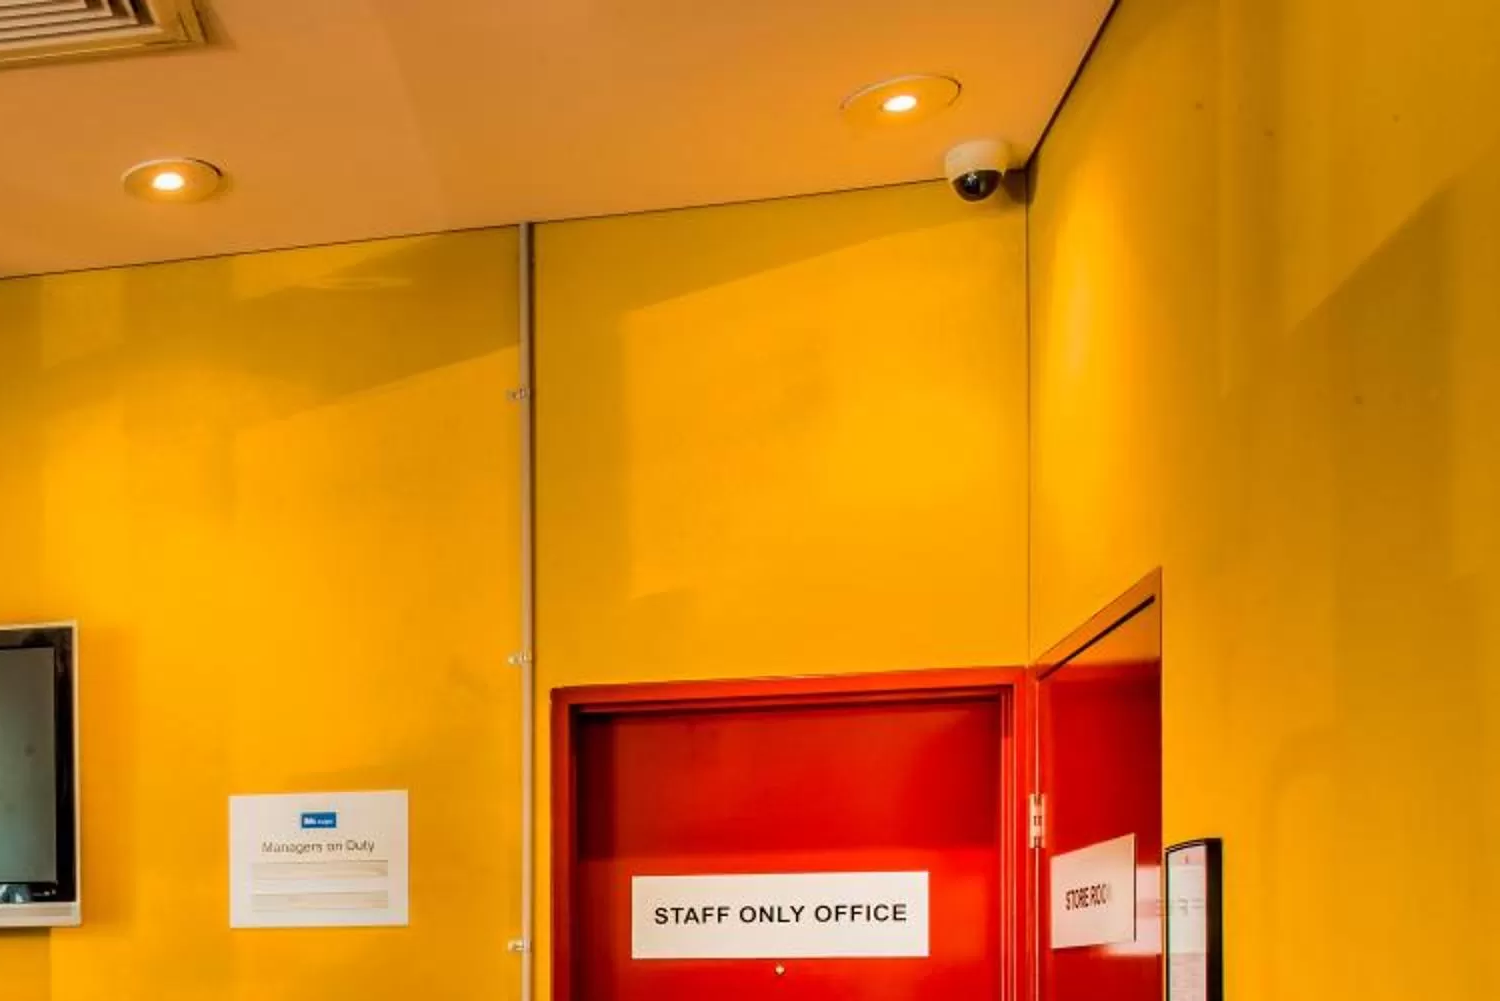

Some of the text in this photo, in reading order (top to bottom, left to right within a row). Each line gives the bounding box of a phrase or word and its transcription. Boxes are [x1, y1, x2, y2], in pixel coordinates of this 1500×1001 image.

[261, 839, 376, 855] Managers on Duty
[1064, 883, 1112, 911] STORE ROO
[654, 903, 907, 925] STAFF ONLY OFFICE
